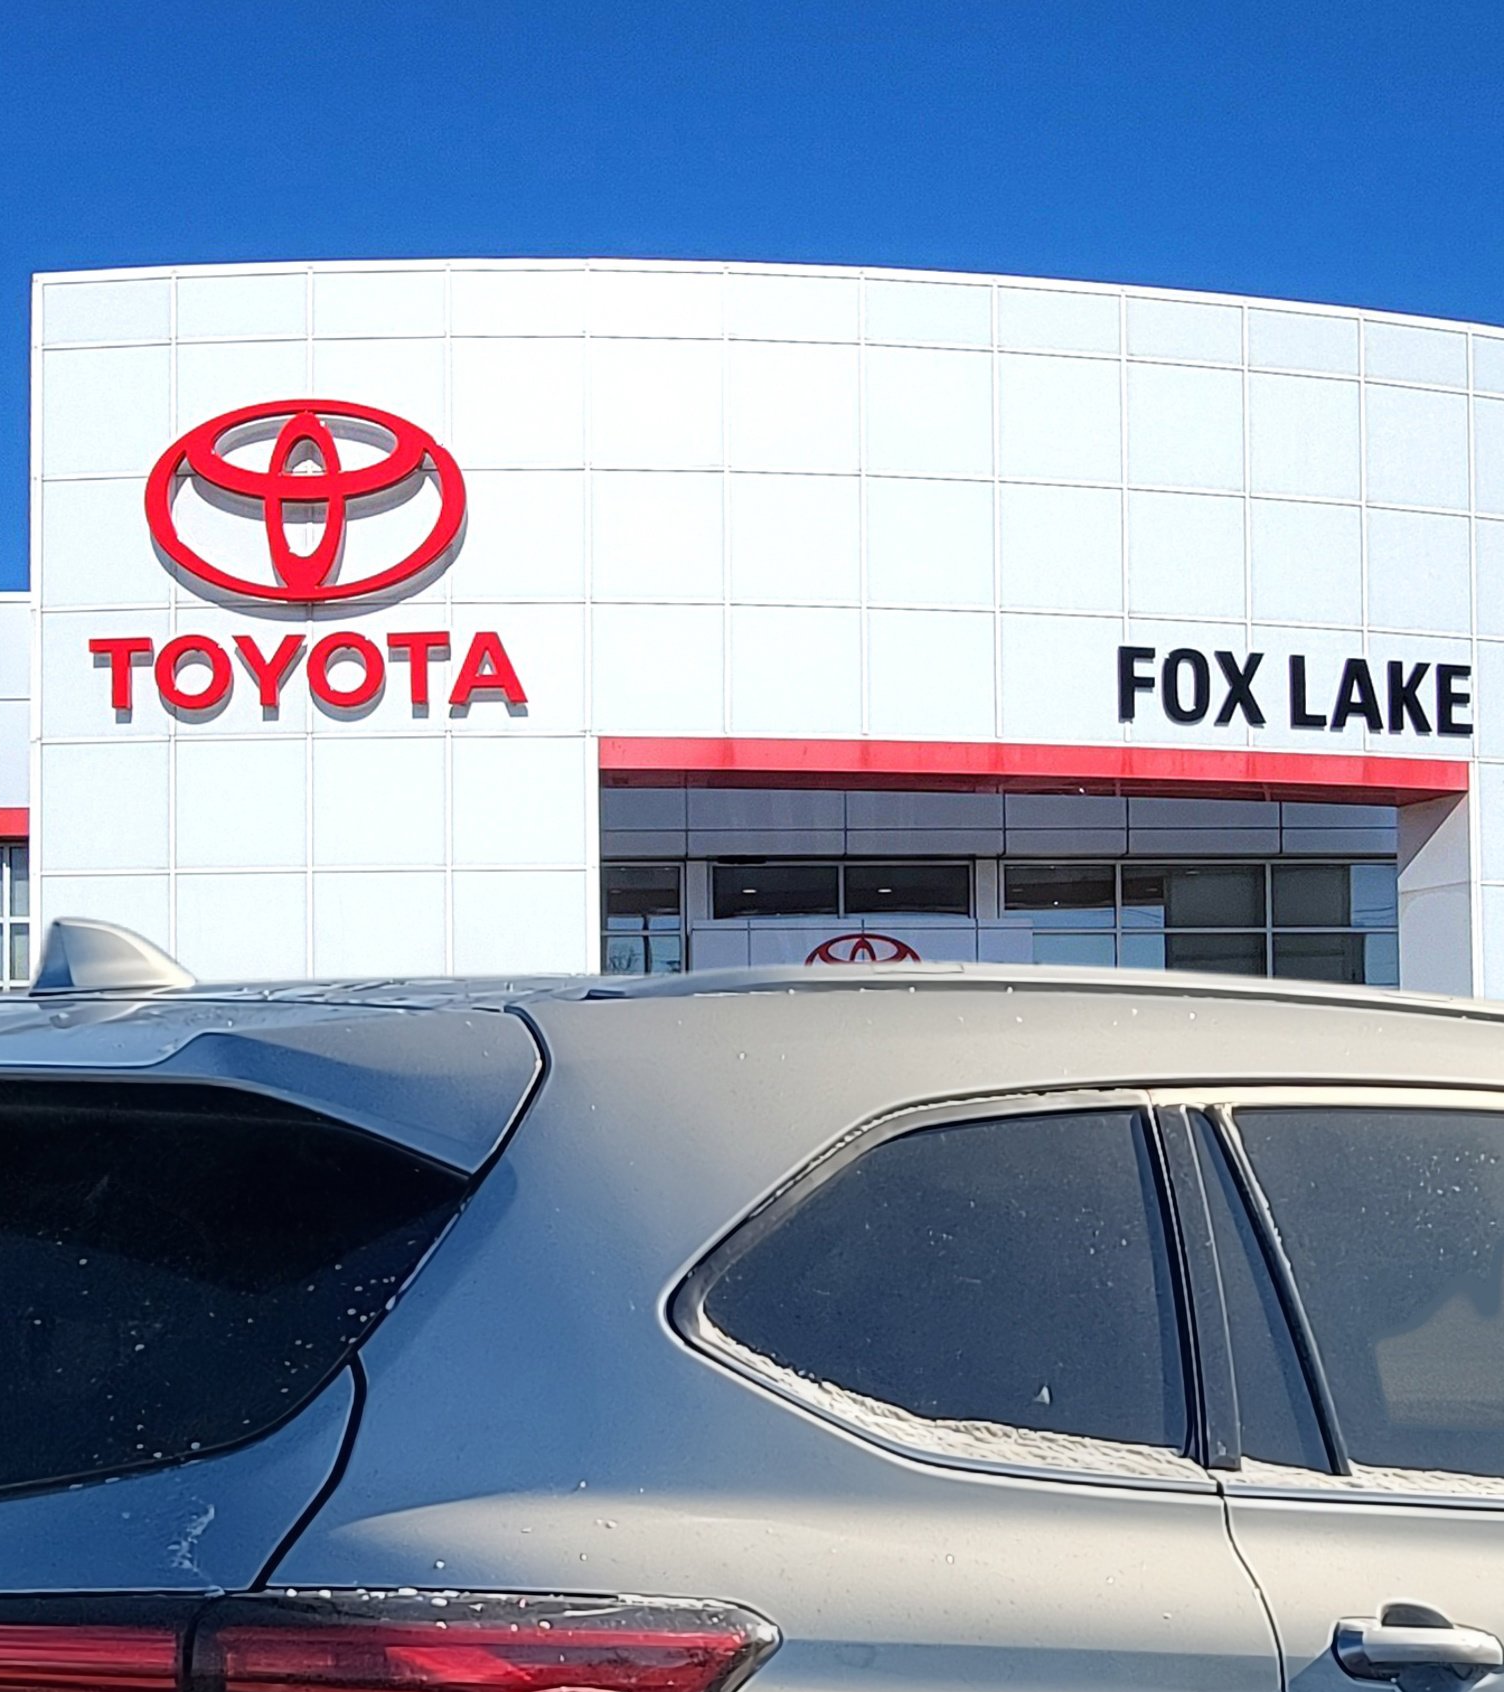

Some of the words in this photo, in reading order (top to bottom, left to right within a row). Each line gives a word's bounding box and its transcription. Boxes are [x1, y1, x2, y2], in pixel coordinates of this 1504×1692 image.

[89, 631, 528, 711] TOYOTA
[1117, 645, 1266, 726] FOX
[1289, 654, 1474, 736] LAKE
